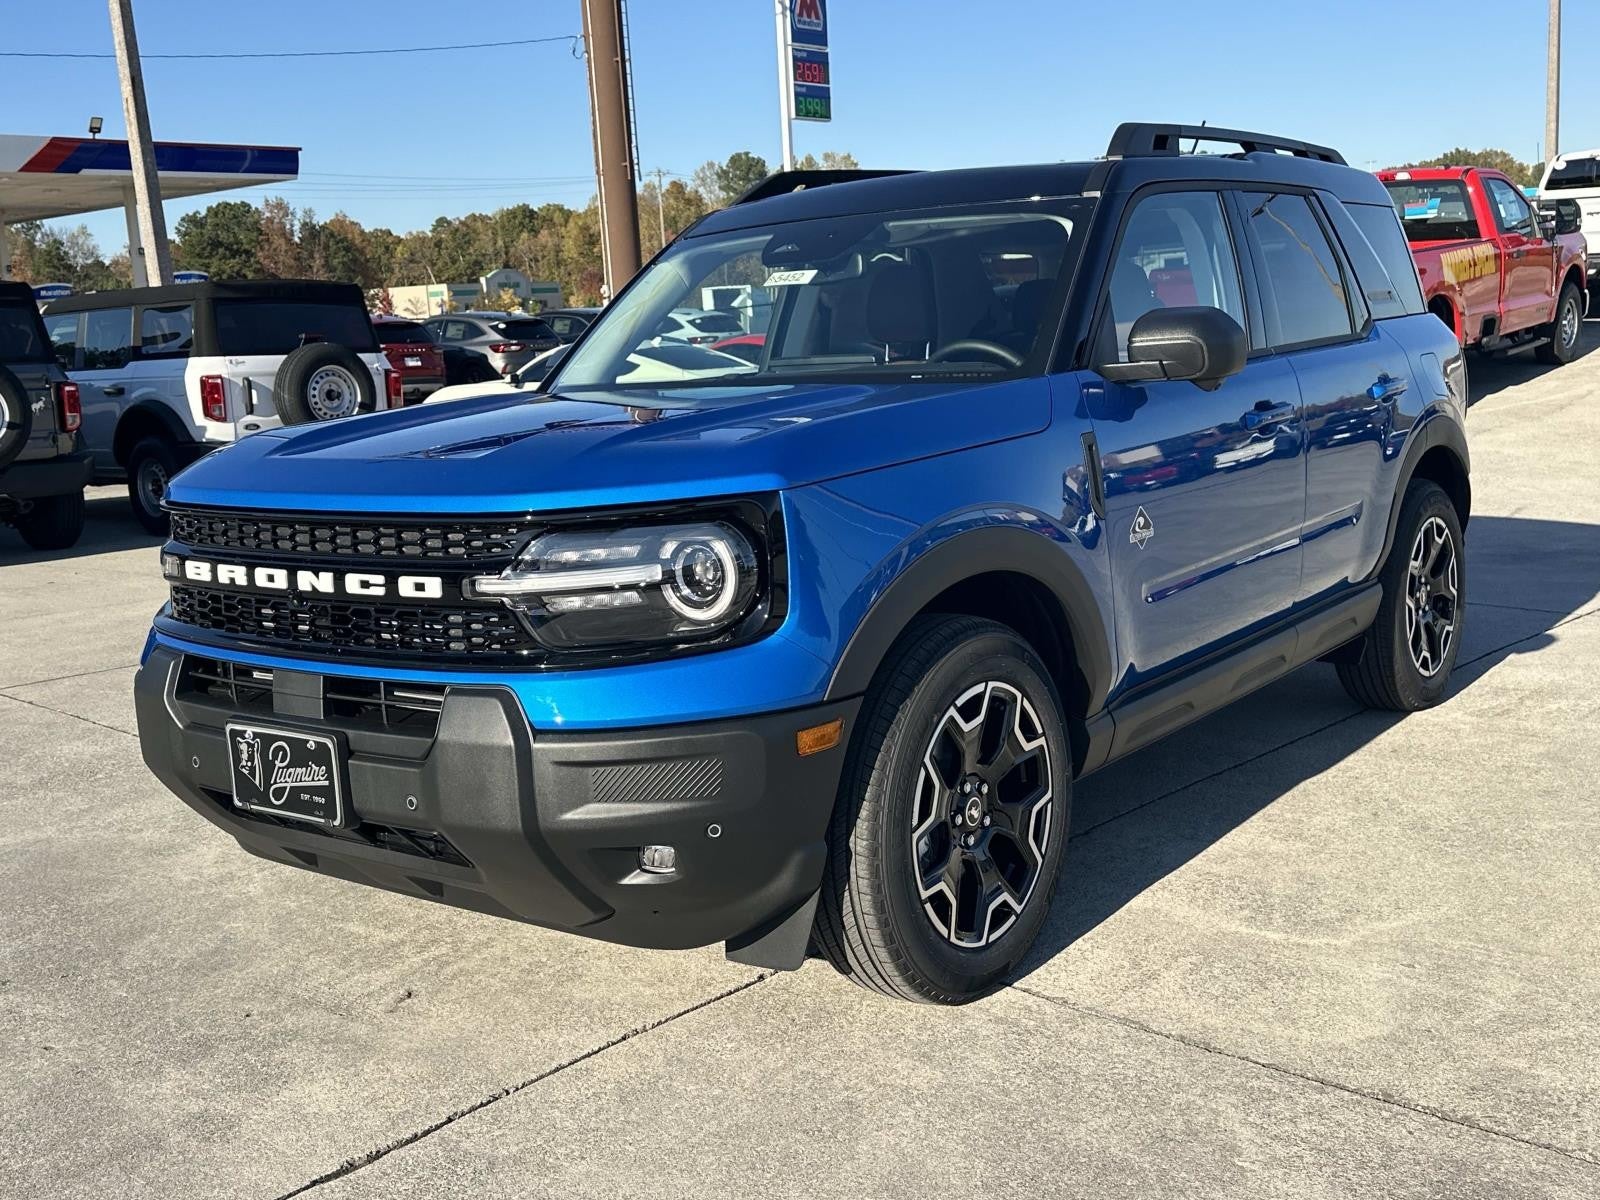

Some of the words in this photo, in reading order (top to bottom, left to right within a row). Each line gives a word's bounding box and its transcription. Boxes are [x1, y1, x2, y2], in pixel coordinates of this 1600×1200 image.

[40, 289, 71, 297] Marathon
[185, 560, 443, 598] BRONCO
[269, 741, 329, 805] Pugmire
